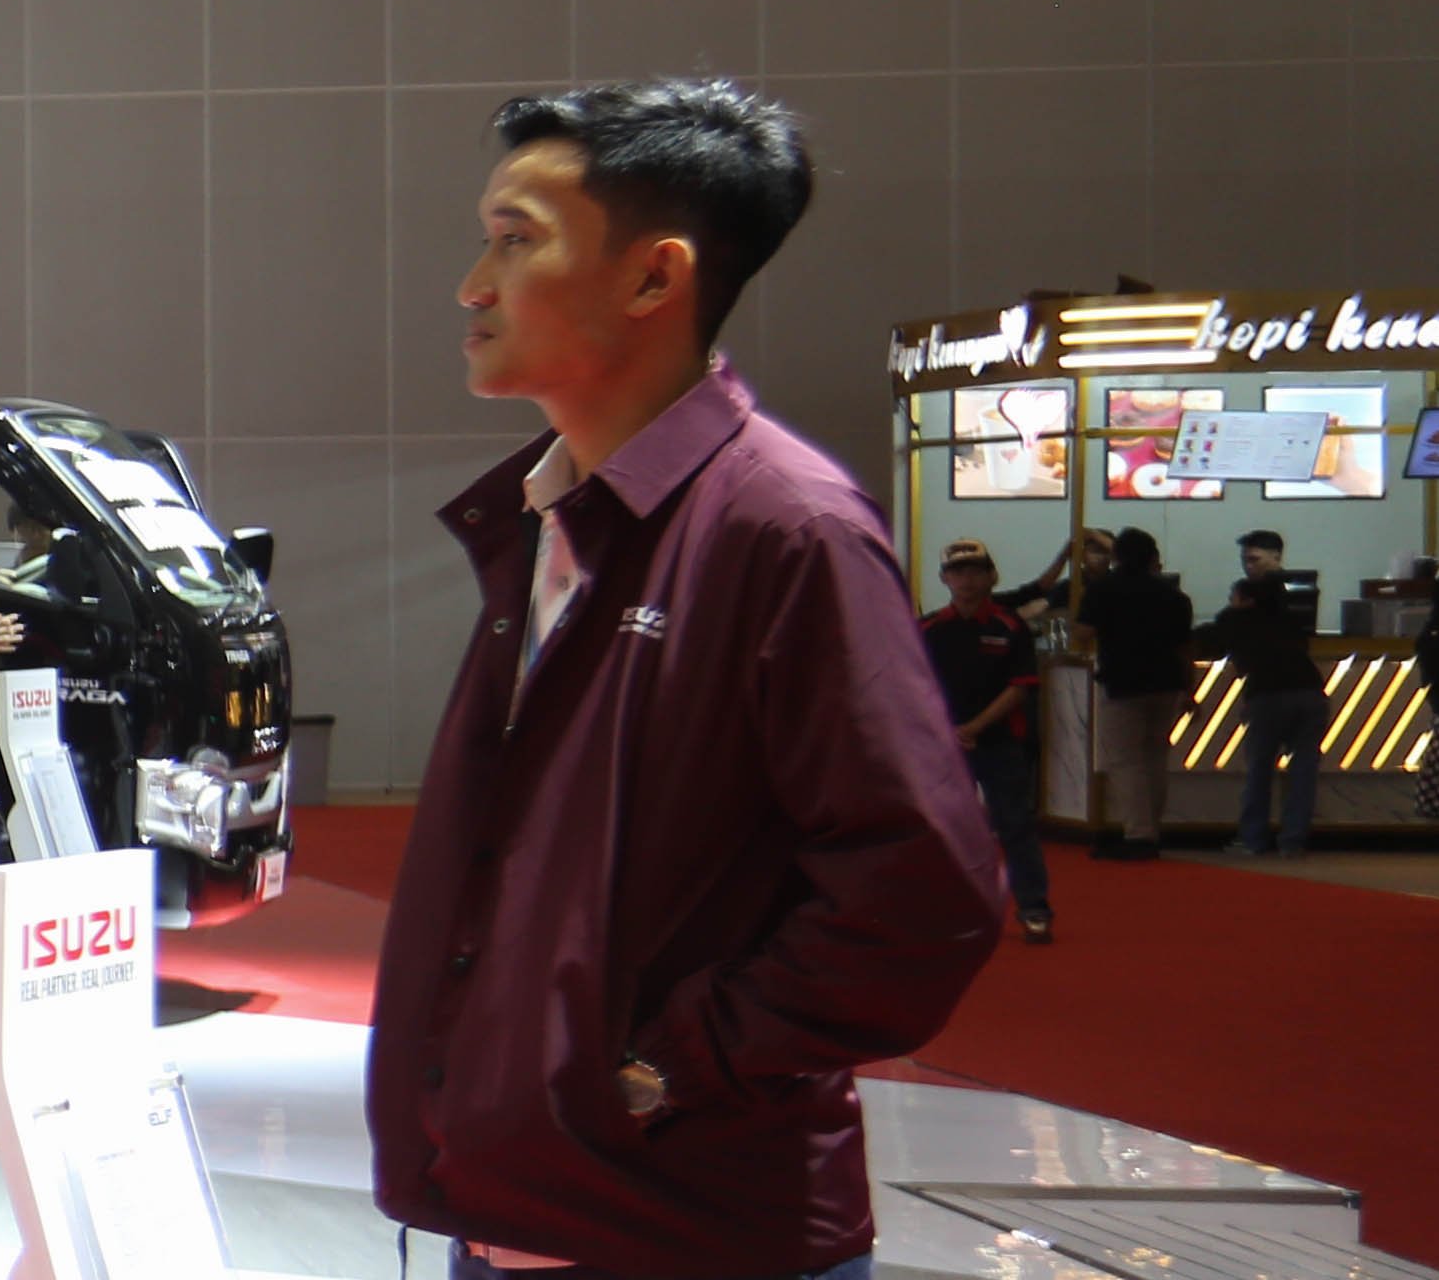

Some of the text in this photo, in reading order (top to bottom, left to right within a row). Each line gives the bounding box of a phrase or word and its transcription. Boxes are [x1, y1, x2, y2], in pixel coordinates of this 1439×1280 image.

[1191, 296, 1316, 360] kopi
[12, 689, 52, 708] ISUZU
[57, 688, 127, 705] RAGA
[21, 905, 137, 971] ISUZU
